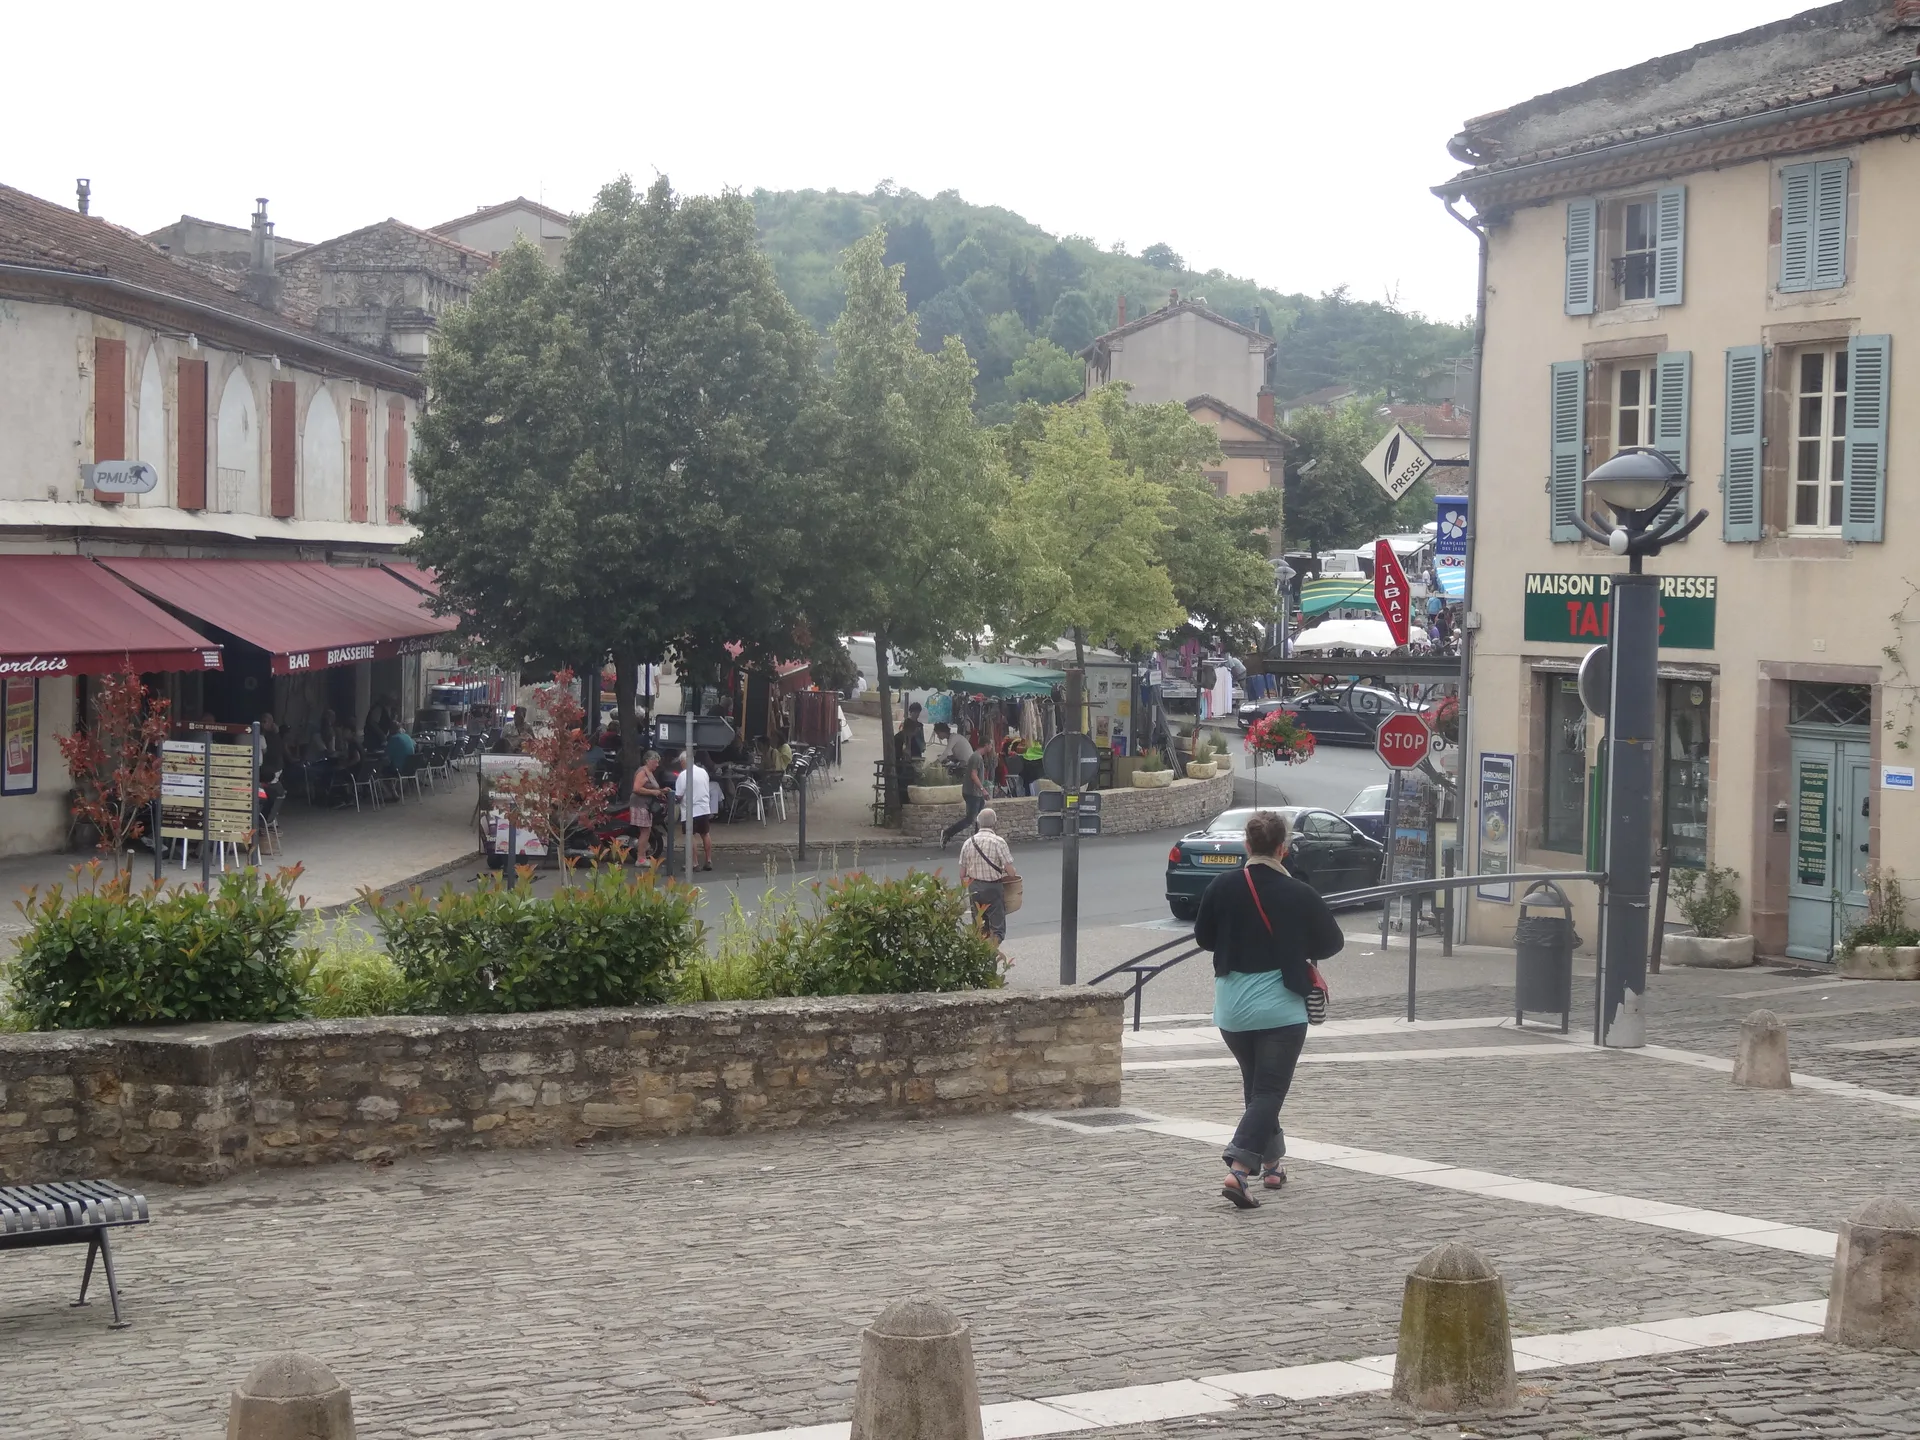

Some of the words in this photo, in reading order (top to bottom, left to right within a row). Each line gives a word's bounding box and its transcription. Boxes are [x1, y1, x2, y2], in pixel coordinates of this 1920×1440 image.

[97, 472, 128, 484] PMU
[1390, 456, 1425, 494] PRESSE
[1439, 555, 1465, 568] LOTO
[1381, 563, 1403, 624] TABAC
[1526, 574, 1594, 595] MAISON
[1600, 575, 1612, 596] D
[0, 656, 69, 673] ordais
[289, 654, 310, 669] BAR
[327, 645, 375, 665] BRASSERIE
[1383, 733, 1425, 749] STOP
